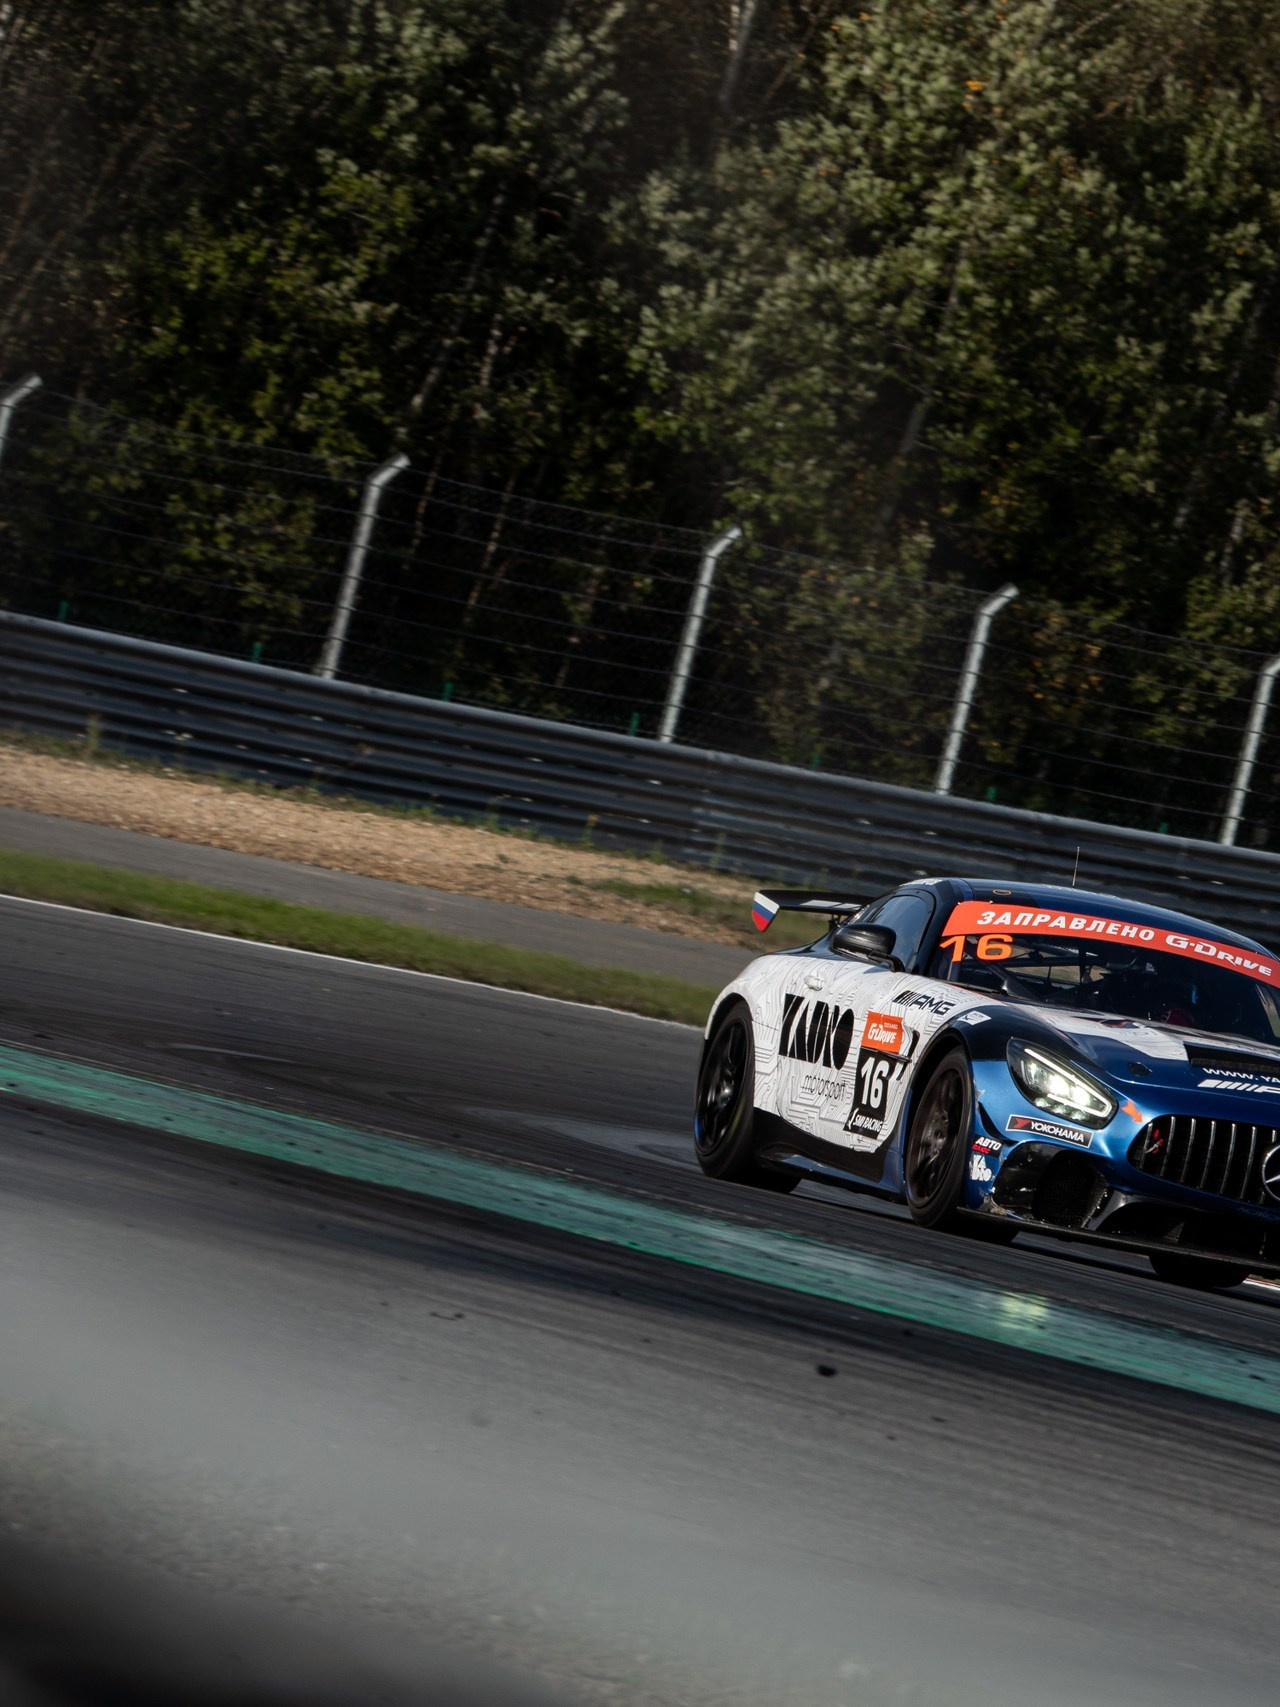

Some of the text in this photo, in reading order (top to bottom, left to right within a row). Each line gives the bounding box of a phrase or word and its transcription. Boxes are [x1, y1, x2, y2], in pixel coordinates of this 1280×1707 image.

[976, 910, 1155, 942] ЗАПРАВЛЕНО
[939, 933, 1014, 963] 16
[802, 1074, 847, 1102] motorsport
[860, 1056, 890, 1109] 16
[974, 1136, 1002, 1151] АВТО
[1029, 1120, 1085, 1143] YOKOHAMA
